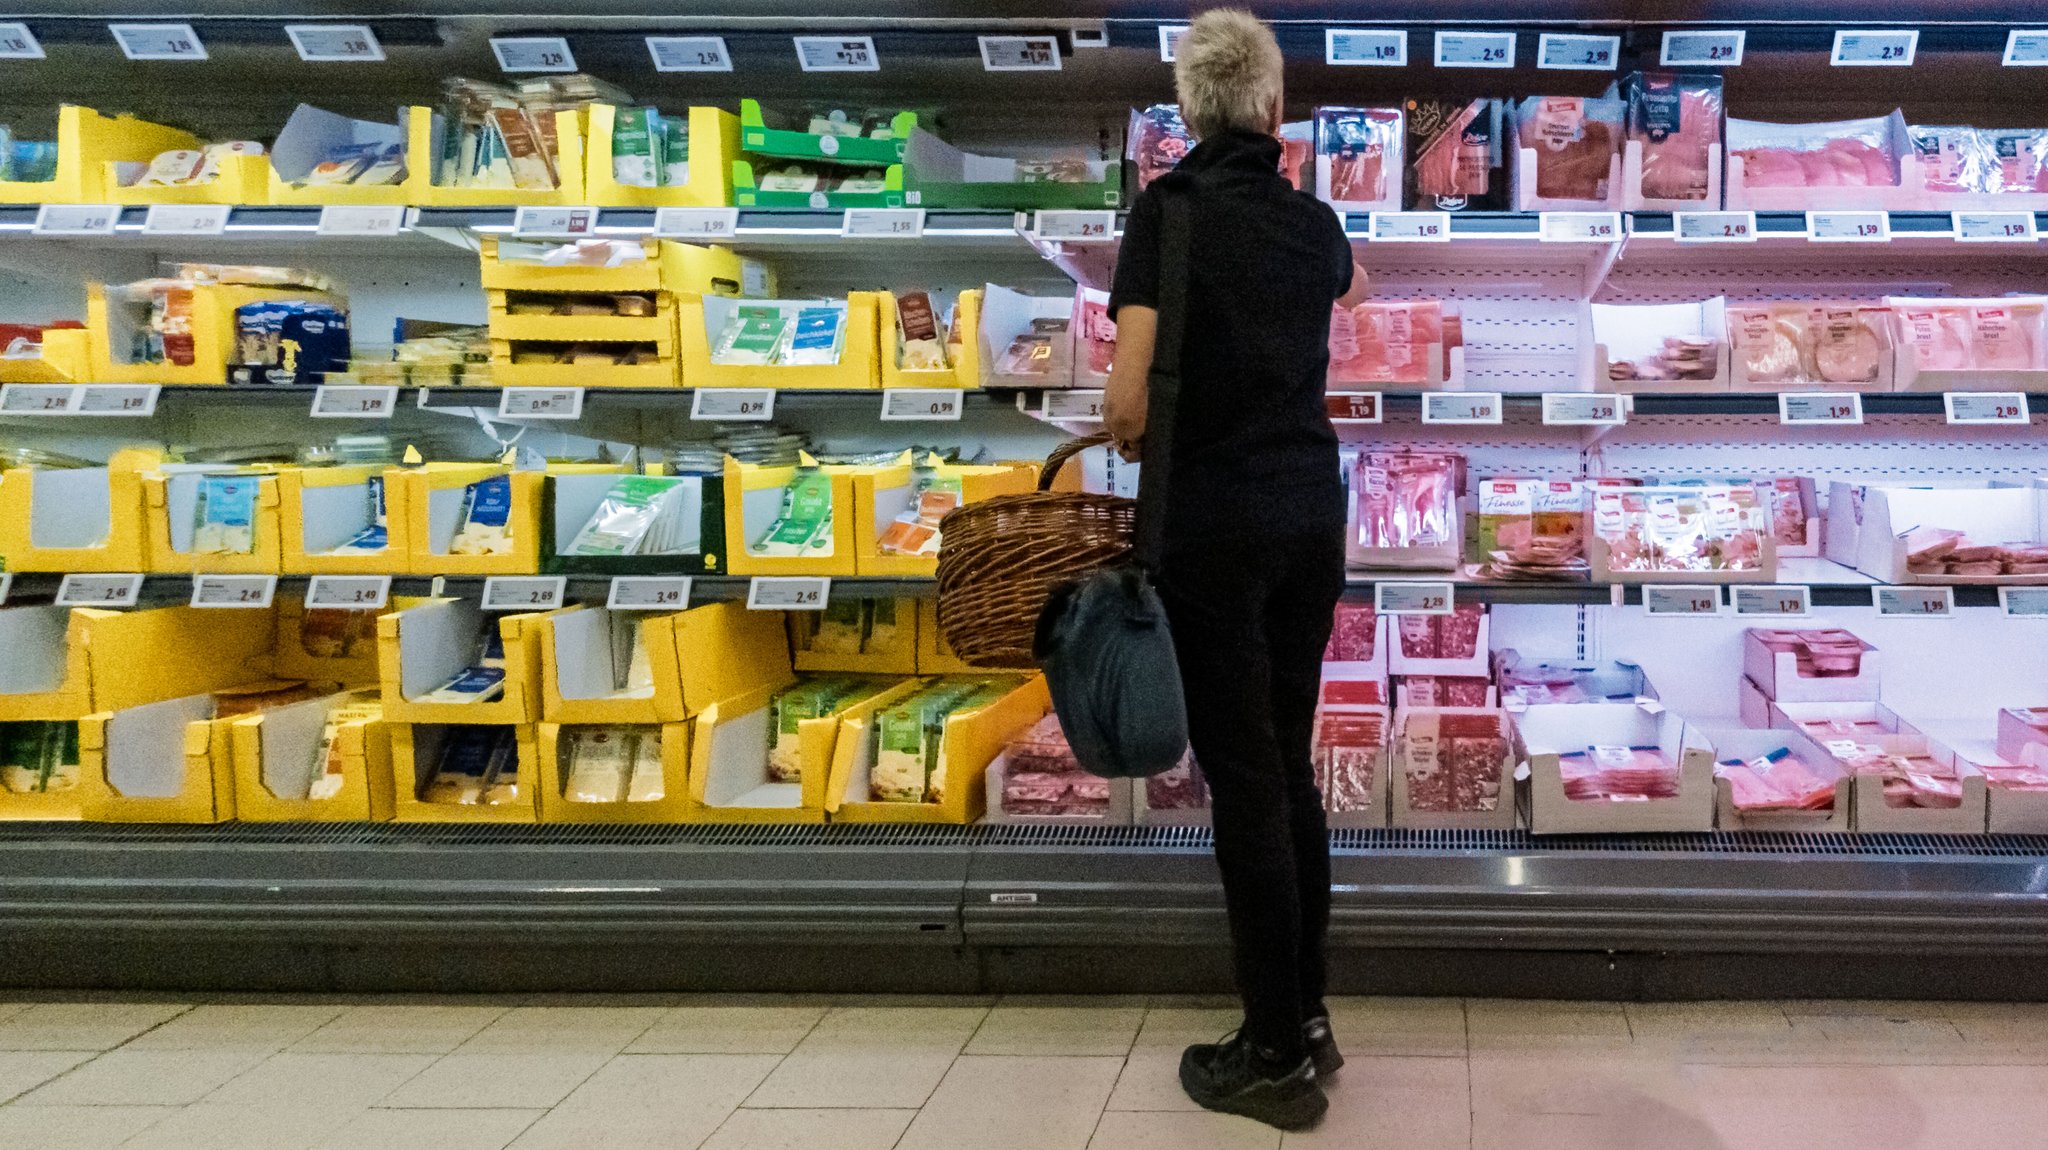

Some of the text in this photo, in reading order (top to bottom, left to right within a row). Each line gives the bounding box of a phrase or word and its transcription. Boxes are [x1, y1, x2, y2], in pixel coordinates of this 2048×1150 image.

[697, 51, 719, 65] 2.59
[845, 52, 868, 65] 2.49
[1374, 46, 1396, 59] 1.89
[1482, 48, 1505, 61] 2.45
[1584, 51, 1609, 64] 2.99
[1709, 46, 1732, 59] 2.39
[1881, 46, 1904, 59] 2.19
[541, 53, 563, 66] 2.29
[703, 221, 725, 233] 1.99
[891, 221, 911, 232] 1.55
[1082, 223, 1105, 236] 2.49
[1418, 225, 1439, 237] 1.65
[1589, 225, 1611, 237] 3.65
[1724, 224, 1747, 237] 2.49
[1857, 224, 1878, 236] 1.59
[2003, 224, 2025, 236] 1.59
[740, 403, 764, 413] 0.99
[930, 403, 954, 414] 0.99
[1350, 405, 1370, 418] 1.19
[1470, 407, 1491, 419] 1.89
[1591, 407, 1613, 419] 2.59
[1829, 406, 1851, 418] 1.99
[1995, 406, 2018, 418] 2.89
[1483, 495, 1525, 508] Finesse
[104, 588, 127, 600] 2.45
[354, 590, 377, 602] 3.49
[530, 591, 553, 604] 2.69
[657, 591, 679, 603] 3.49
[796, 592, 818, 604] 2.45
[1422, 597, 1444, 609] 2.29
[1690, 599, 1711, 612] 1.49
[1779, 600, 1799, 612] 1.79
[1922, 601, 1943, 613] 1.99
